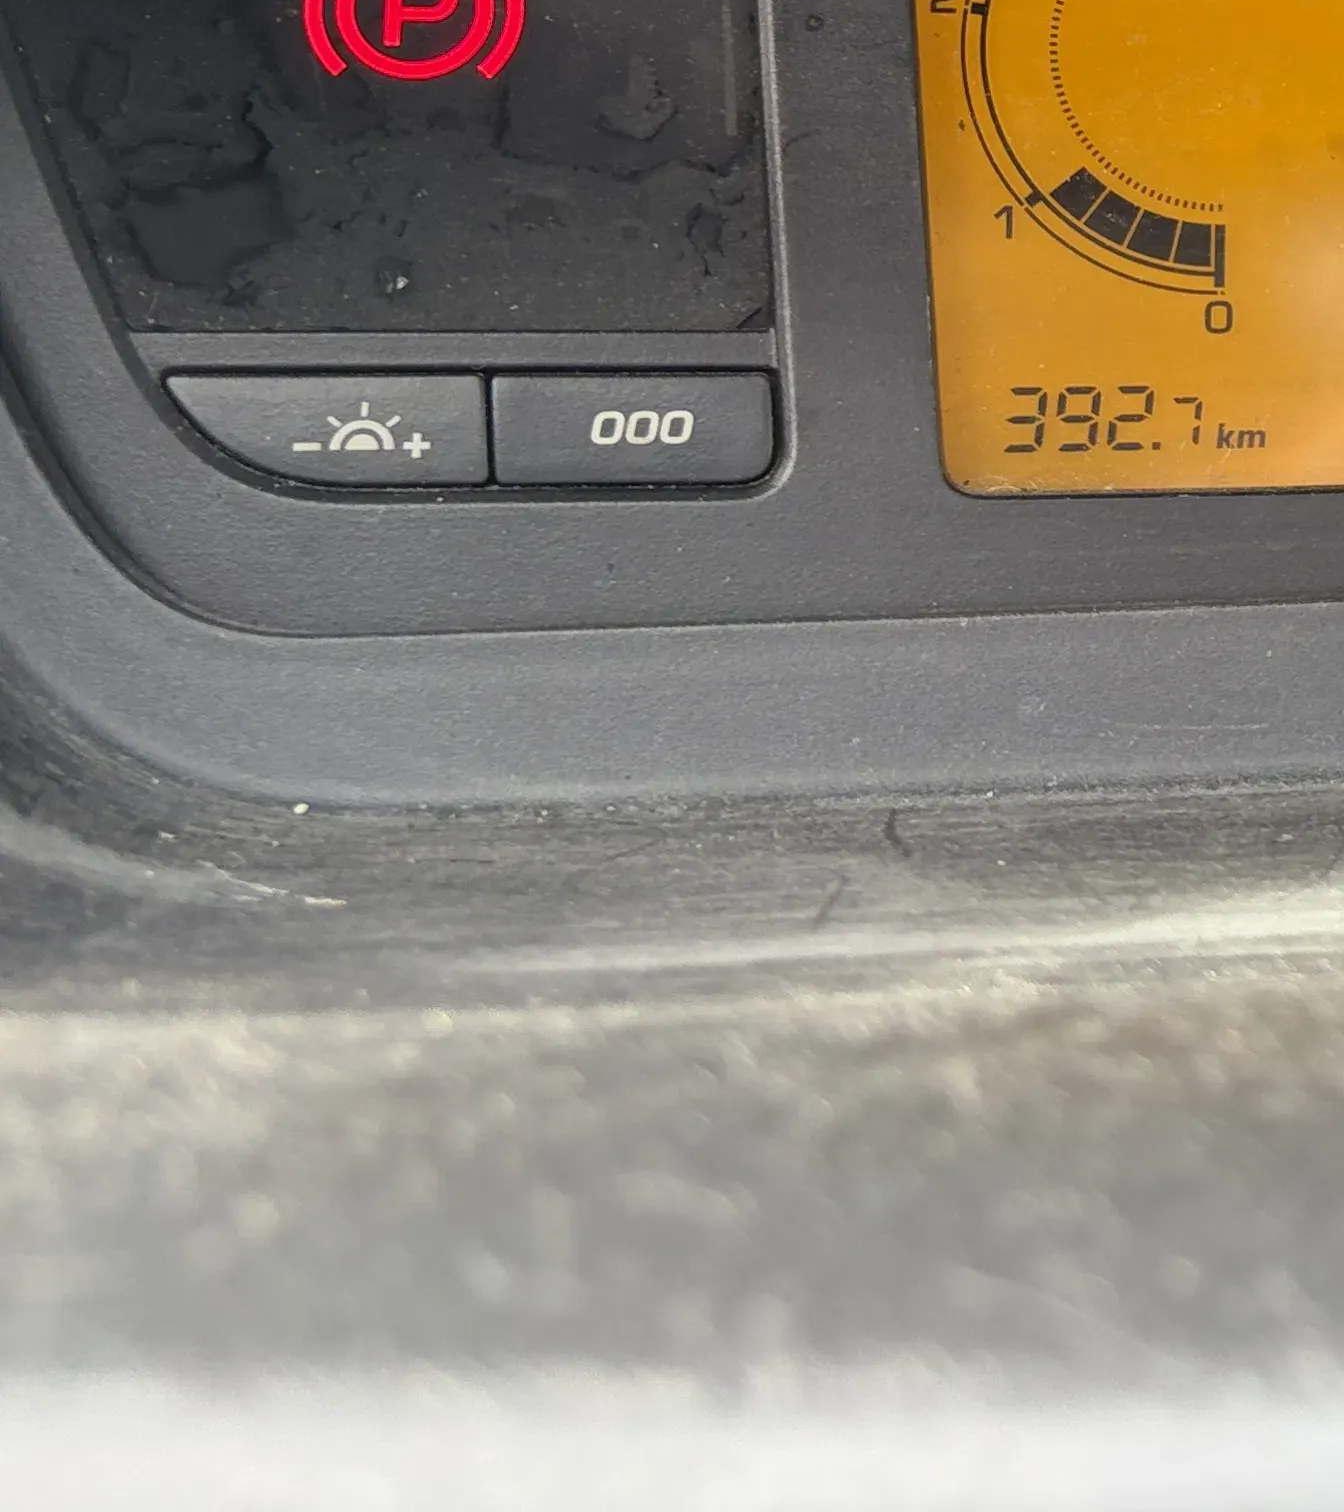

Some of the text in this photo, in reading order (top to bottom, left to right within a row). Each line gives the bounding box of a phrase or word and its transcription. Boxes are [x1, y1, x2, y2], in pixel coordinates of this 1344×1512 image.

[994, 205, 1015, 240] 1
[1205, 300, 1233, 334] 0
[1003, 385, 1266, 454] 392.7 km
